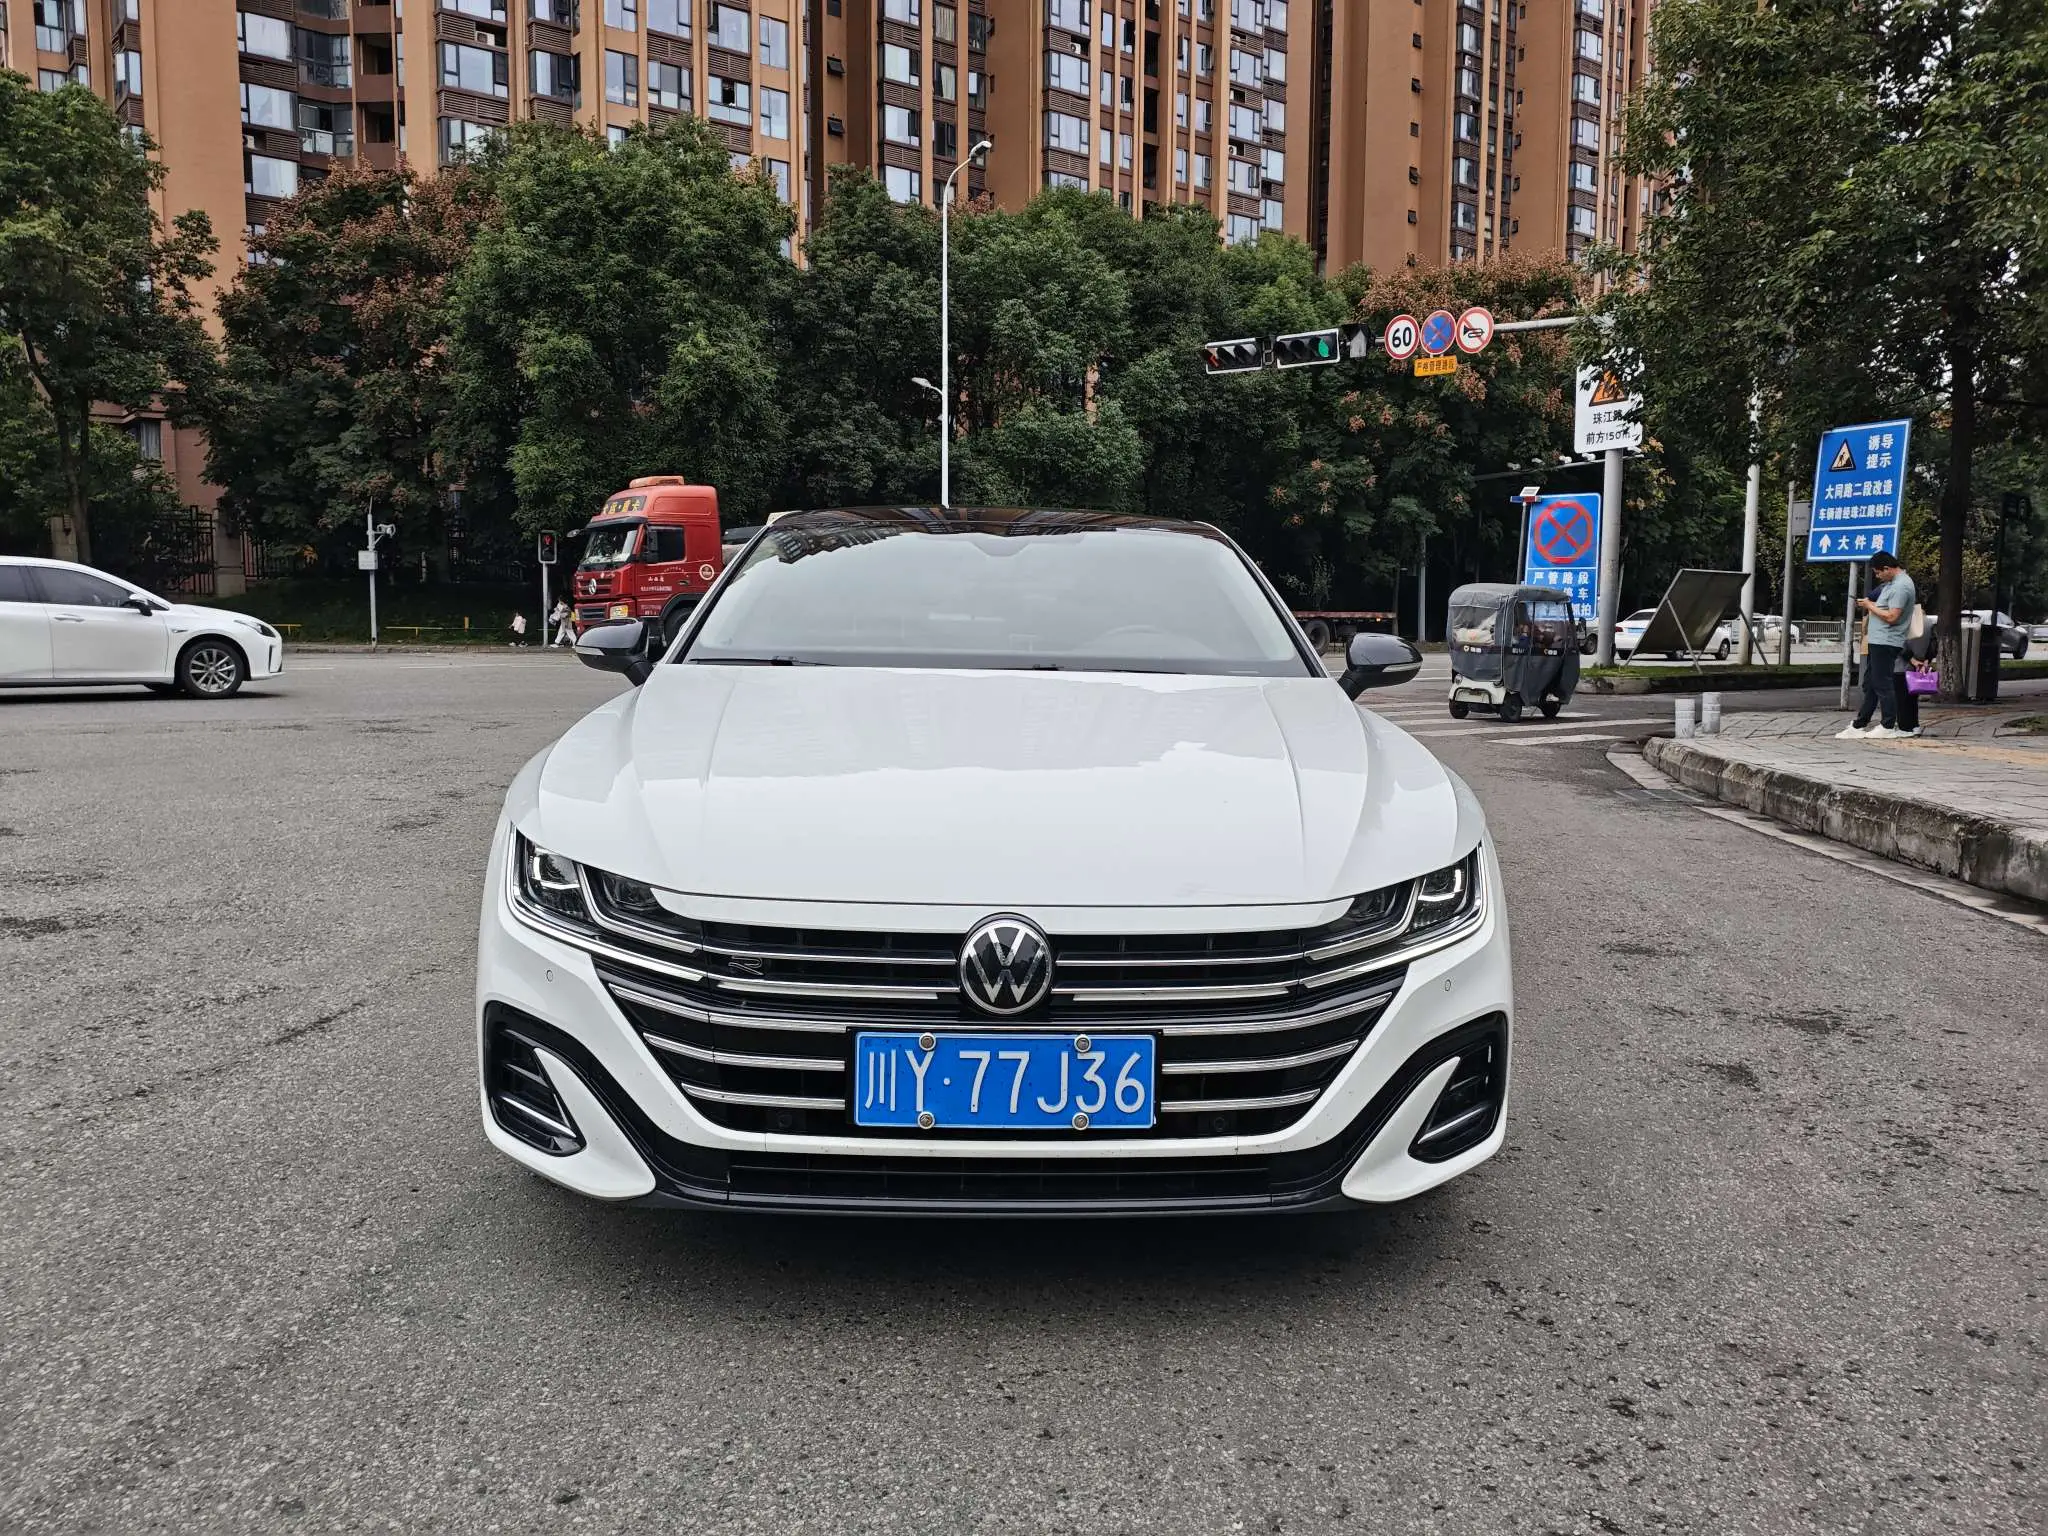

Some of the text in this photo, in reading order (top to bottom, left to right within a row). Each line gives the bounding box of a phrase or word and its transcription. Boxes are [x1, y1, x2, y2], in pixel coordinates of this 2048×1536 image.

[1392, 326, 1412, 348] 60
[1592, 409, 1623, 424] 珠江路
[1868, 433, 1894, 451] 诱导
[1866, 452, 1893, 469] 提示
[1825, 479, 1893, 500] 大同路二段改造
[1818, 503, 1893, 521] 车辆请经珠江路绕行
[1838, 534, 1884, 552] 大件路
[1532, 571, 1589, 585] 严管路段
